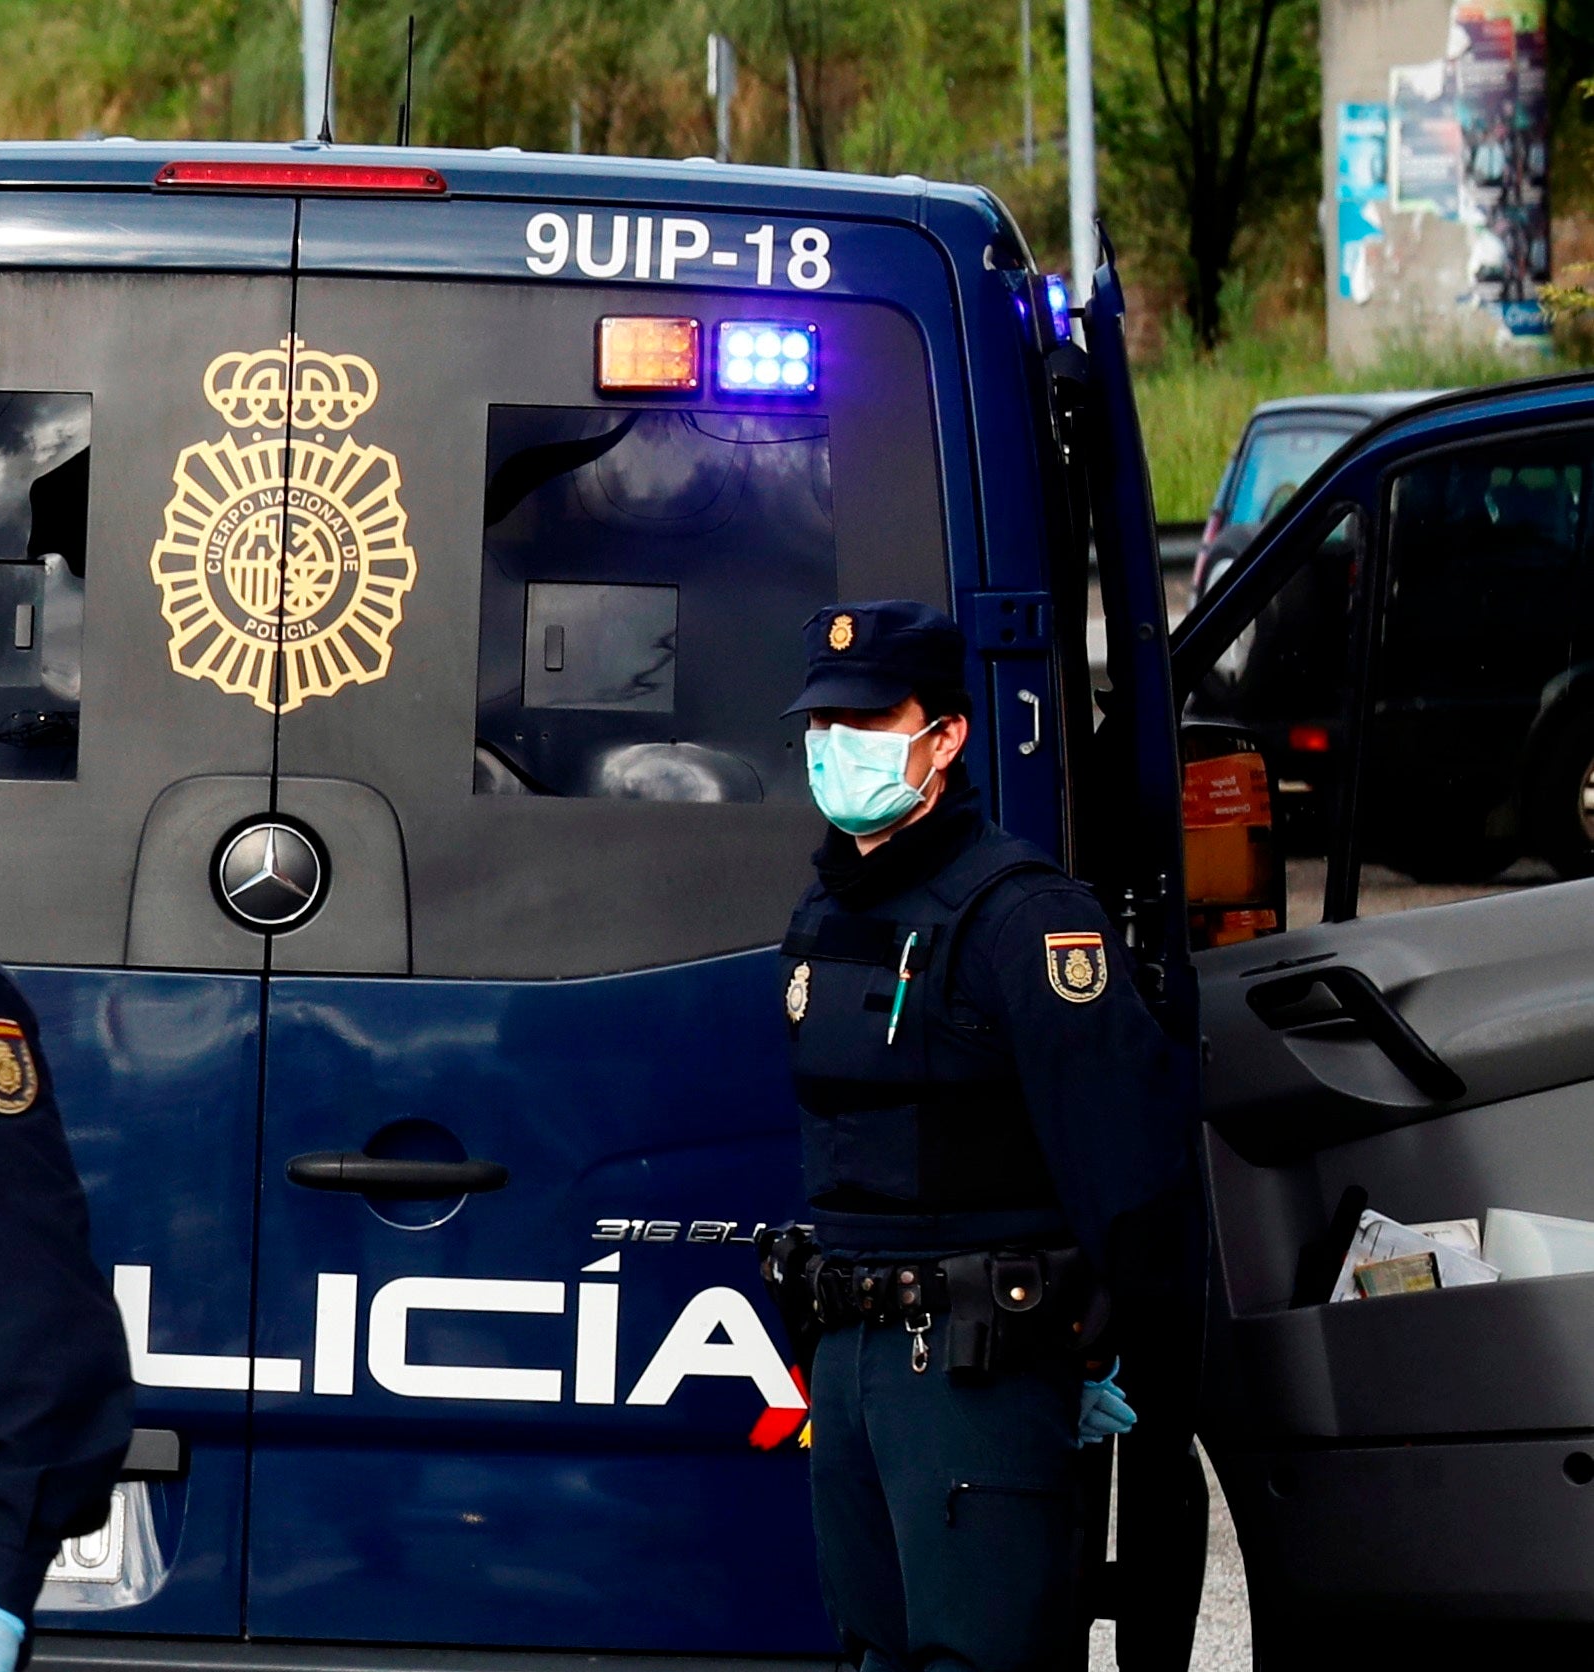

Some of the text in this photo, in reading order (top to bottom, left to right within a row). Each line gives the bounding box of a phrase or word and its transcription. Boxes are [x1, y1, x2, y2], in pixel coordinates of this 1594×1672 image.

[525, 211, 833, 291] 9UIP-18
[206, 489, 359, 574] CUERPO NACIONAL DE
[243, 618, 319, 640] POLICIA
[591, 1218, 682, 1242] 316
[114, 1252, 810, 1410] LICÍA
